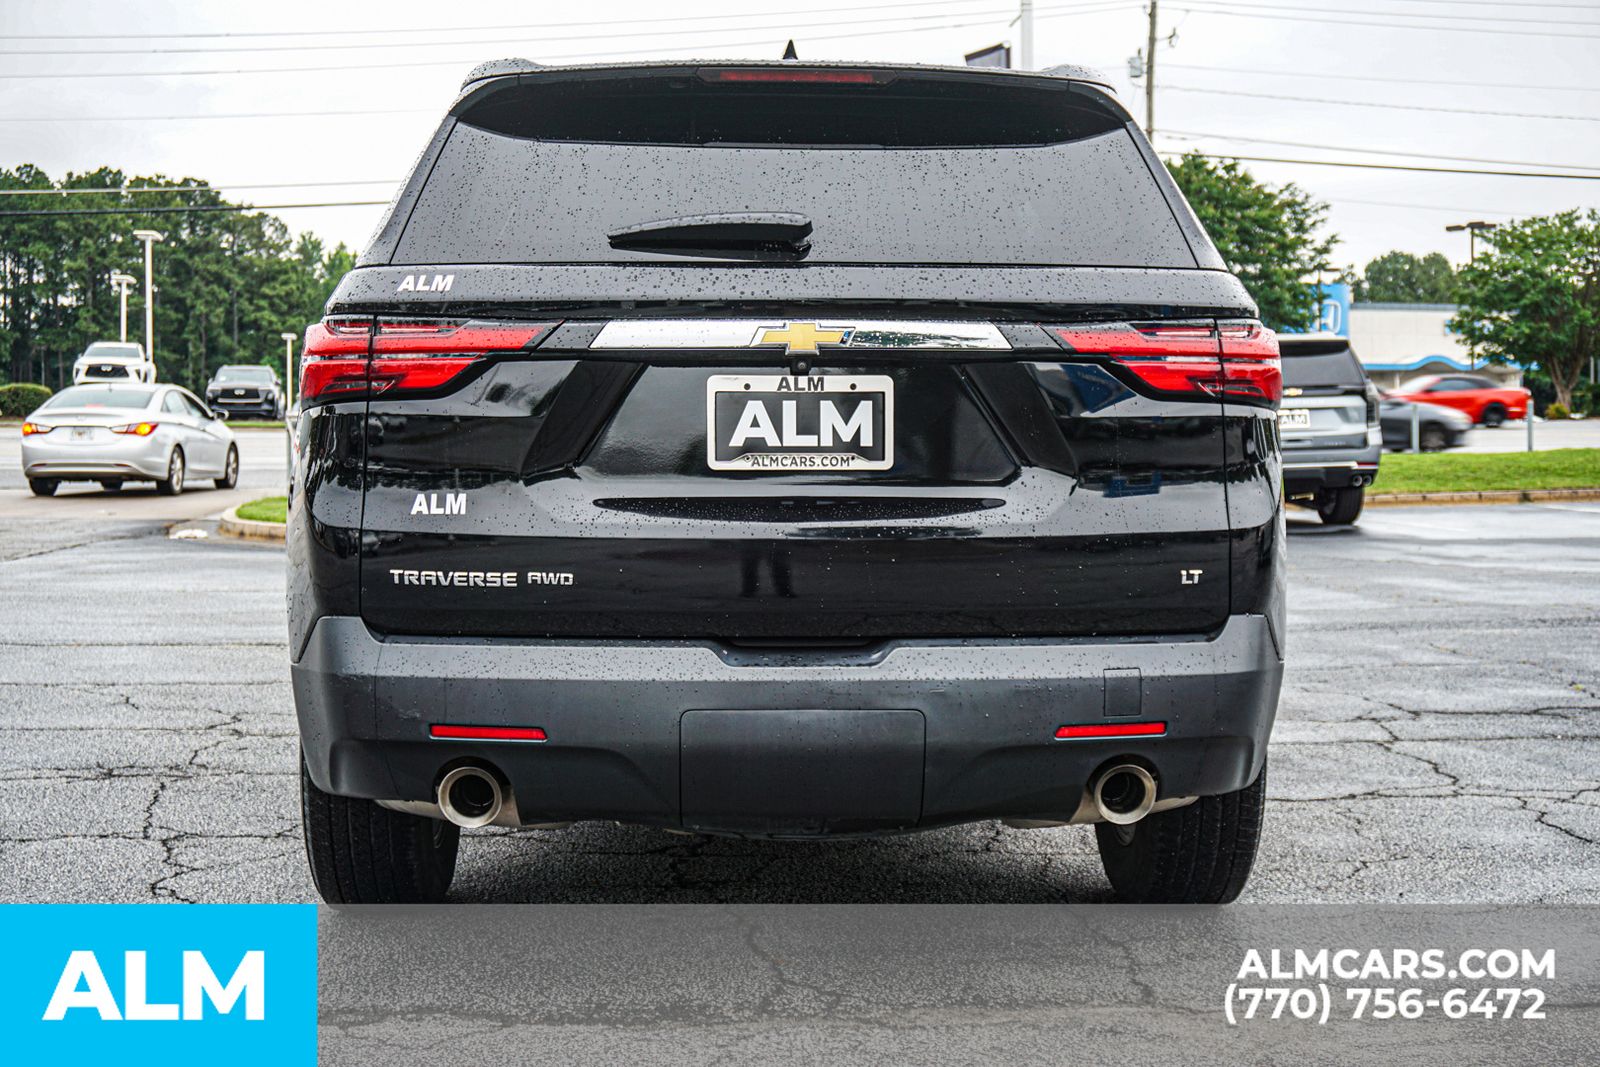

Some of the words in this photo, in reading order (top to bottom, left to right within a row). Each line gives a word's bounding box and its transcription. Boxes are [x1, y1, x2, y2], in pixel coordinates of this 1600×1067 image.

[397, 275, 454, 292] ALM
[777, 376, 825, 392] ALM
[728, 400, 874, 447] ALM
[751, 455, 851, 468] ALMCARS.COM
[410, 493, 467, 515] ALM
[389, 569, 518, 587] TRAVERSE
[527, 571, 574, 587] AWD
[1180, 569, 1204, 585] LT
